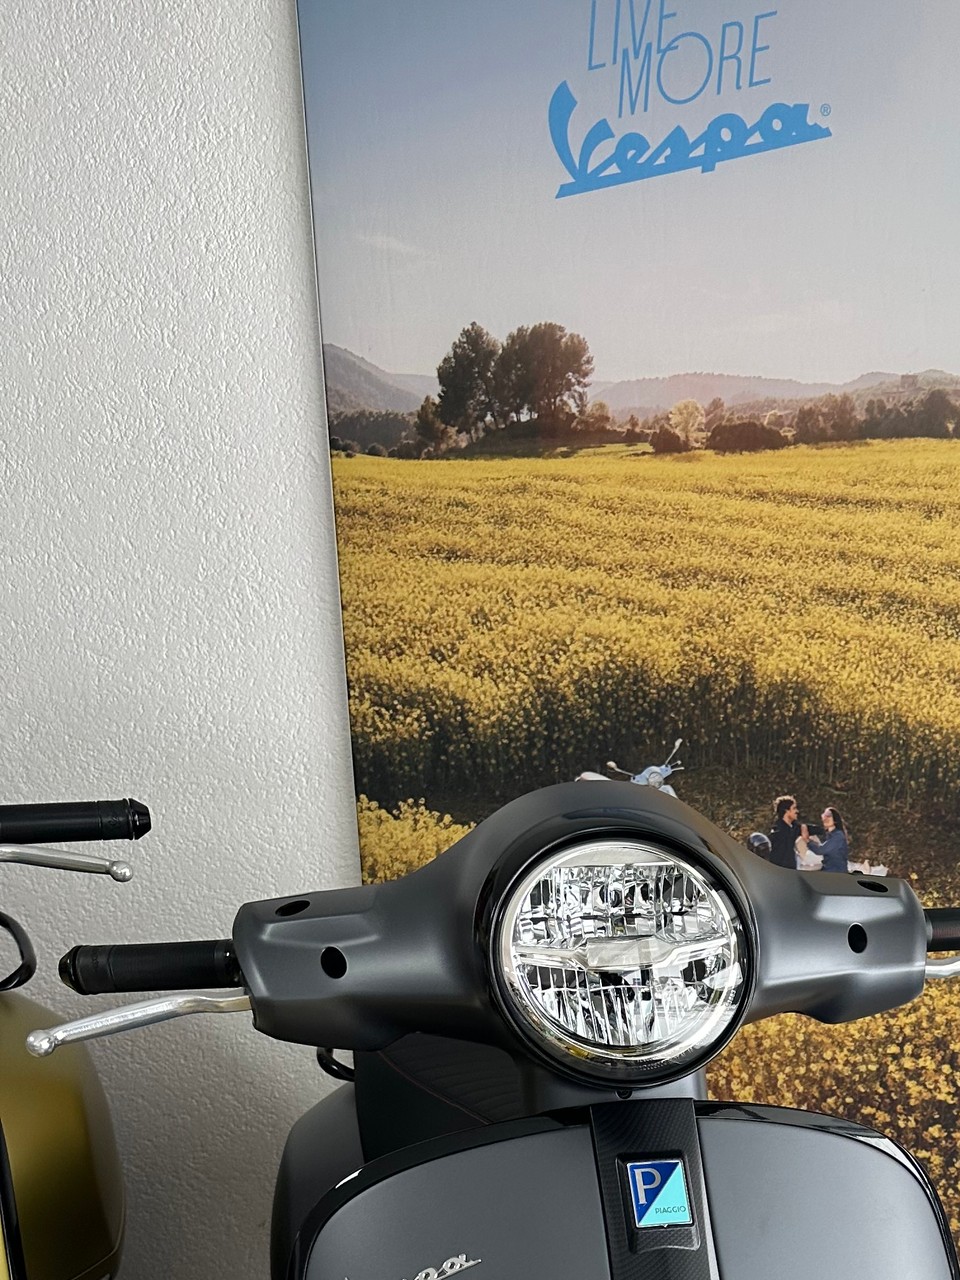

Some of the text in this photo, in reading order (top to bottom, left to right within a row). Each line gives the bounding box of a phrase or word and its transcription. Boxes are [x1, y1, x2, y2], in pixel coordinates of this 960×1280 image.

[586, 0, 680, 71] LIVE
[618, 10, 778, 119] MORE
[633, 1167, 662, 1206] P
[654, 1205, 687, 1215] PIAGGIO
